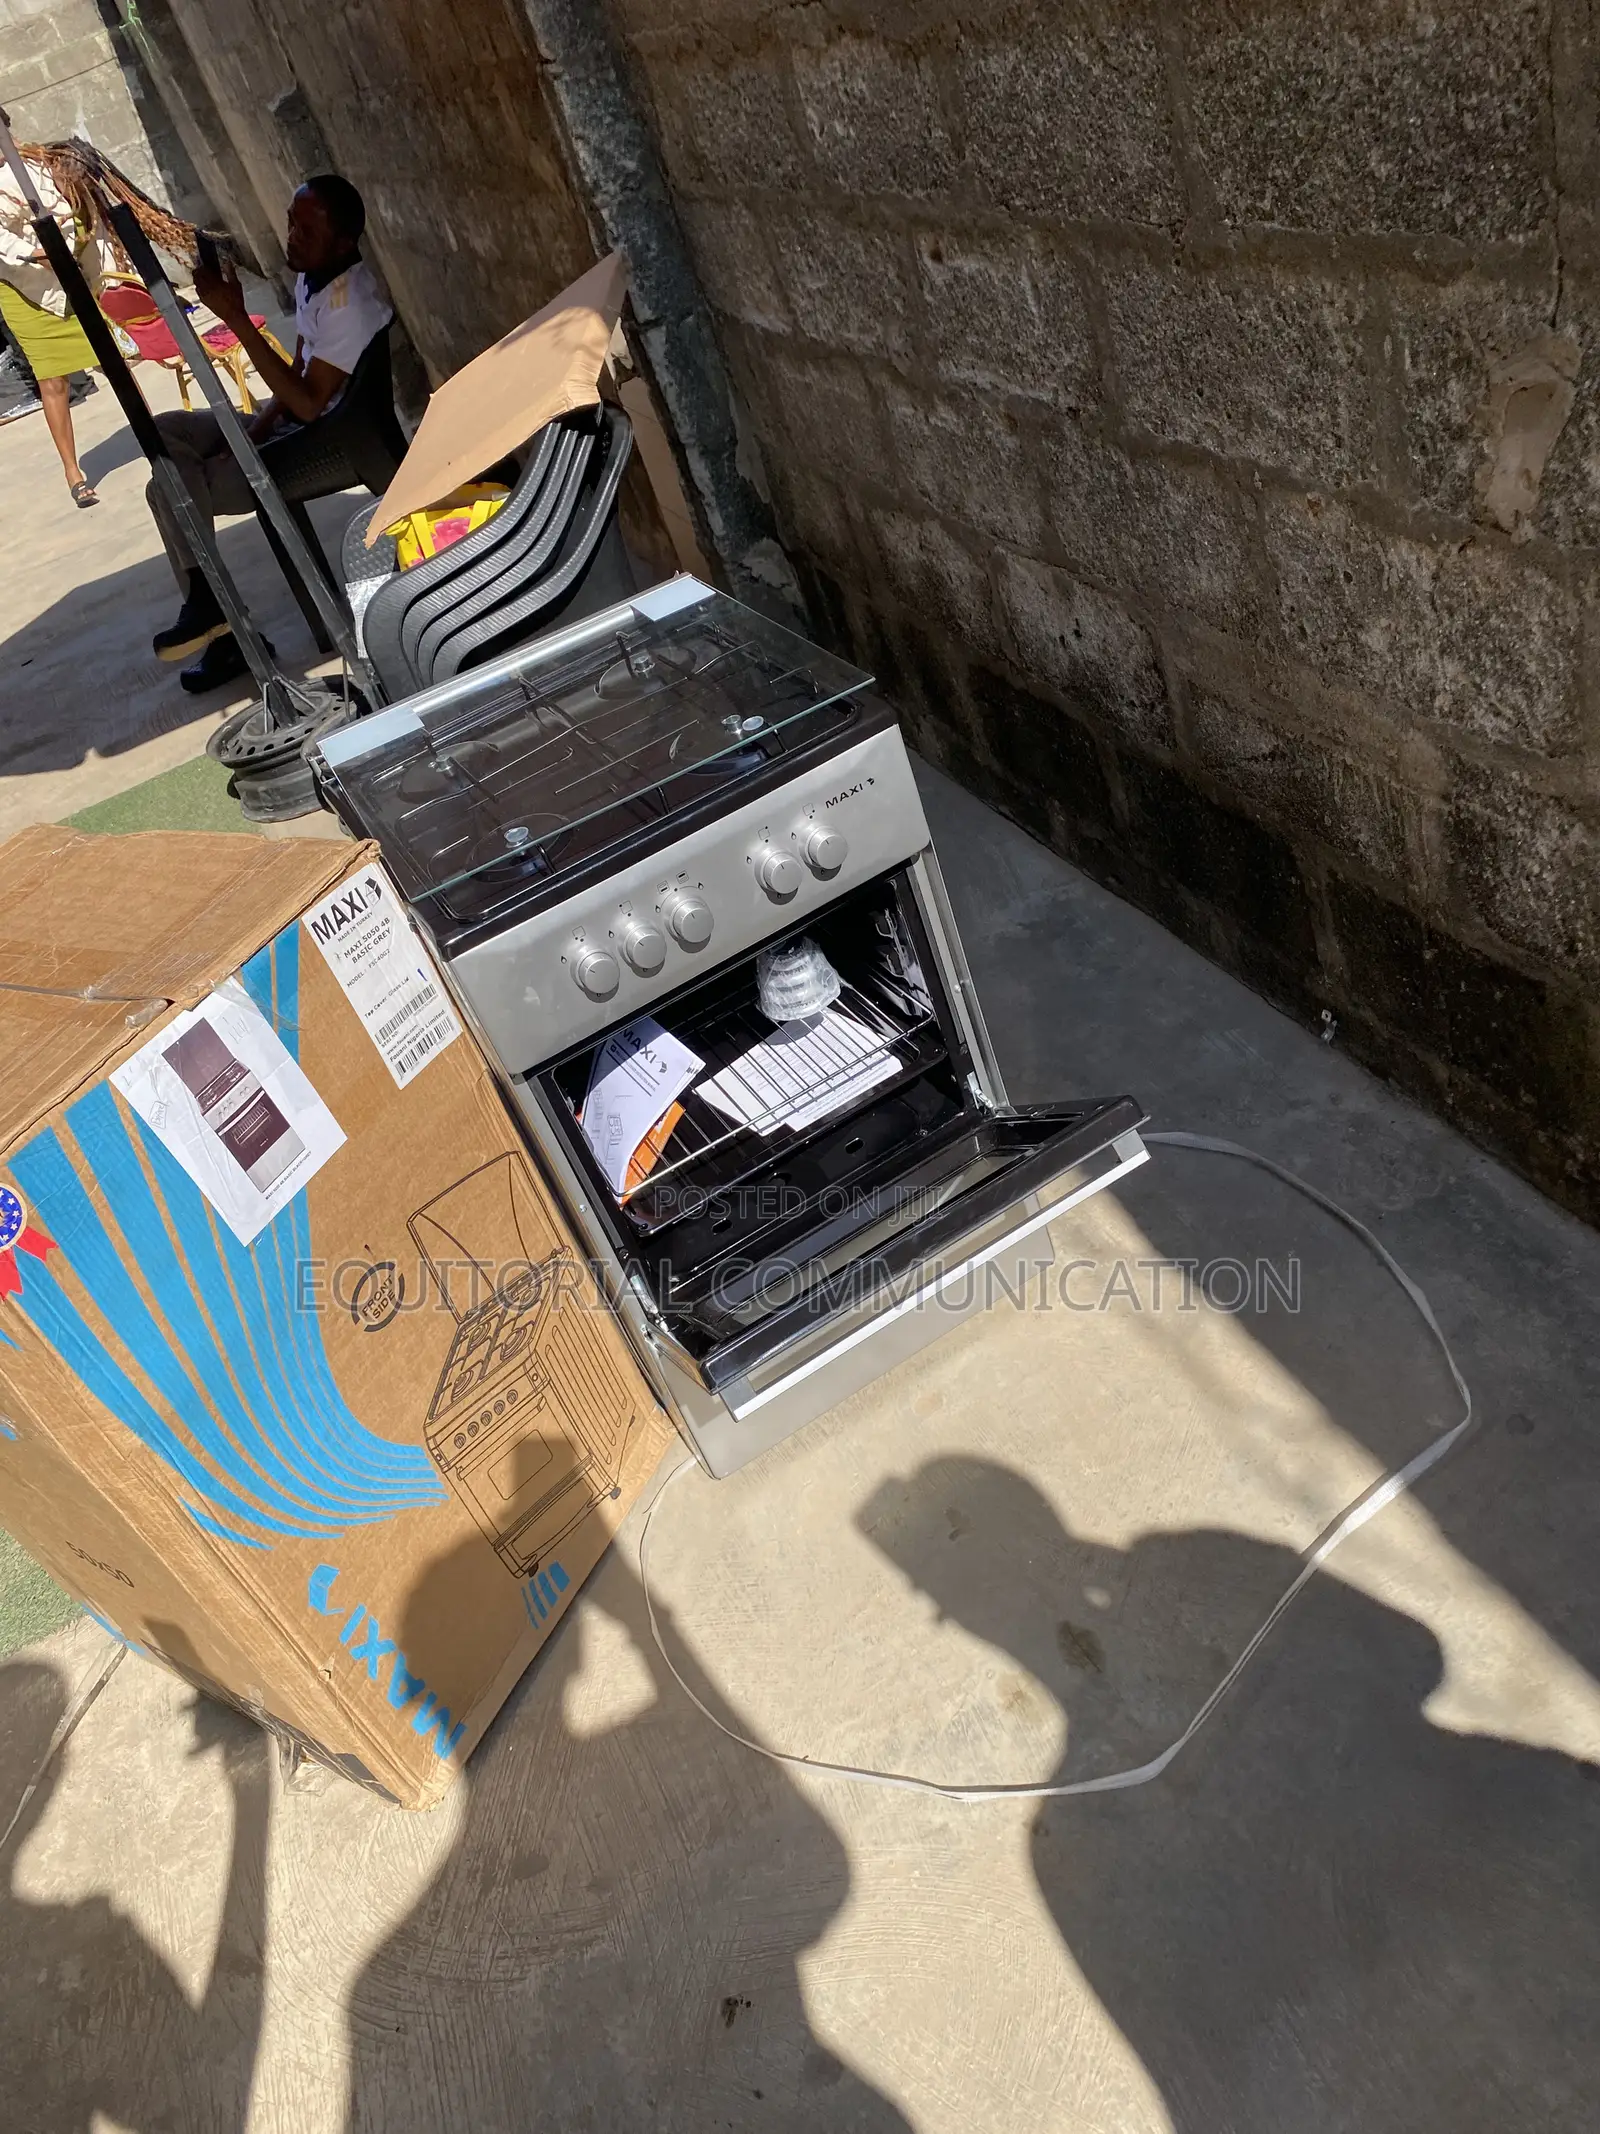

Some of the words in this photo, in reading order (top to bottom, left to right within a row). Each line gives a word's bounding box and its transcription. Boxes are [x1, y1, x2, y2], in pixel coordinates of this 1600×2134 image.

[825, 783, 863, 809] MAXI
[311, 887, 369, 945] MAXI
[337, 930, 350, 942] MADE
[356, 912, 373, 926] TURKEY
[344, 940, 363, 959] MAXI
[362, 925, 380, 943] 5050
[381, 917, 391, 928] 4B
[351, 942, 373, 964] BASIC
[373, 927, 391, 945] GREY
[623, 1028, 657, 1064] MAXI
[362, 1275, 393, 1317] FRONT
[372, 1290, 395, 1319] SIDE
[338, 1603, 468, 1760] MAXI
